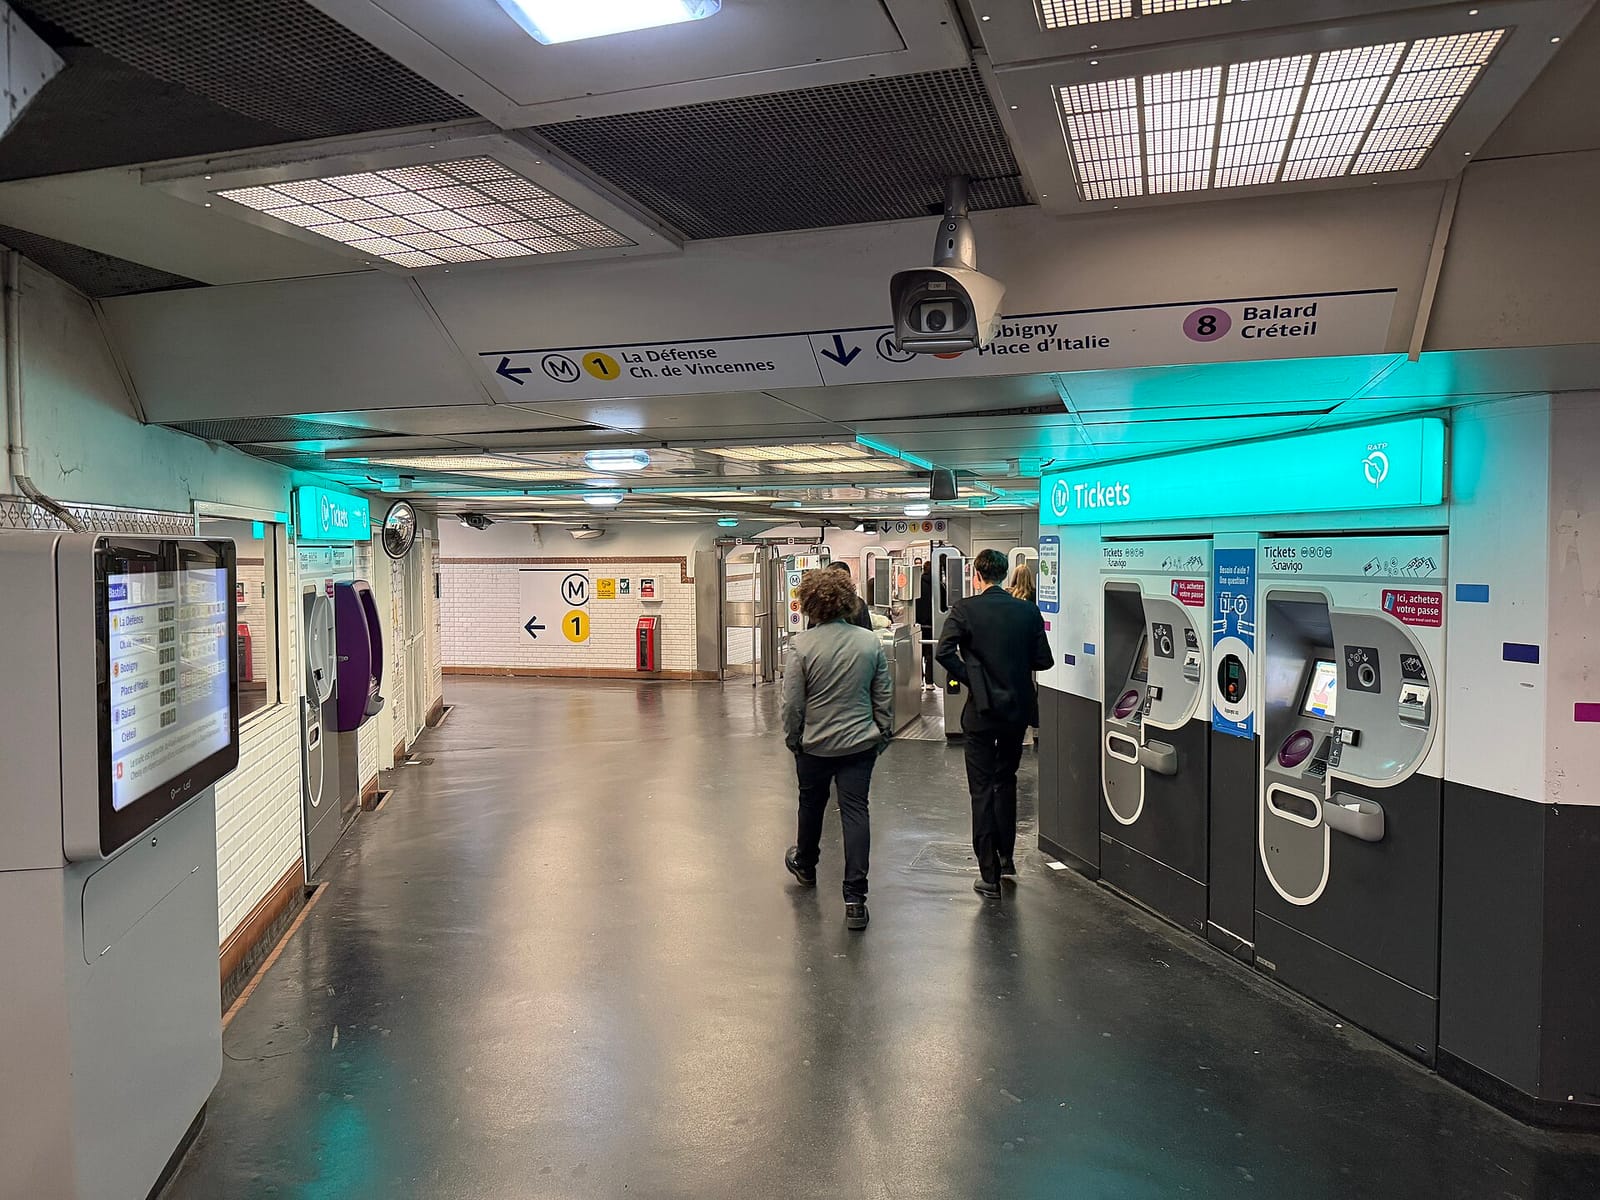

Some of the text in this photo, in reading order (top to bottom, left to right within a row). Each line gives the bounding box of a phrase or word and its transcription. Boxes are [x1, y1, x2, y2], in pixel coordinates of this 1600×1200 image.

[1243, 302, 1317, 320] Balard
[995, 323, 1058, 339] bigny
[1197, 315, 1217, 336] 8
[1241, 322, 1317, 338] Créteil
[979, 335, 1110, 356] Place d'Italie
[621, 348, 718, 364] La Défense
[629, 360, 776, 378] Ch. de Vincennes
[1367, 442, 1388, 451] RATP
[1074, 480, 1131, 508] Tickets
[329, 503, 349, 528] Tickets
[1103, 548, 1123, 558] Tickets
[1264, 546, 1296, 558] Tickets
[1274, 560, 1303, 573] navigo
[1396, 593, 1440, 605] Ici, achetez
[1396, 605, 1439, 616] votre passe
[126, 615, 144, 626] Défense
[120, 685, 133, 697] Place
